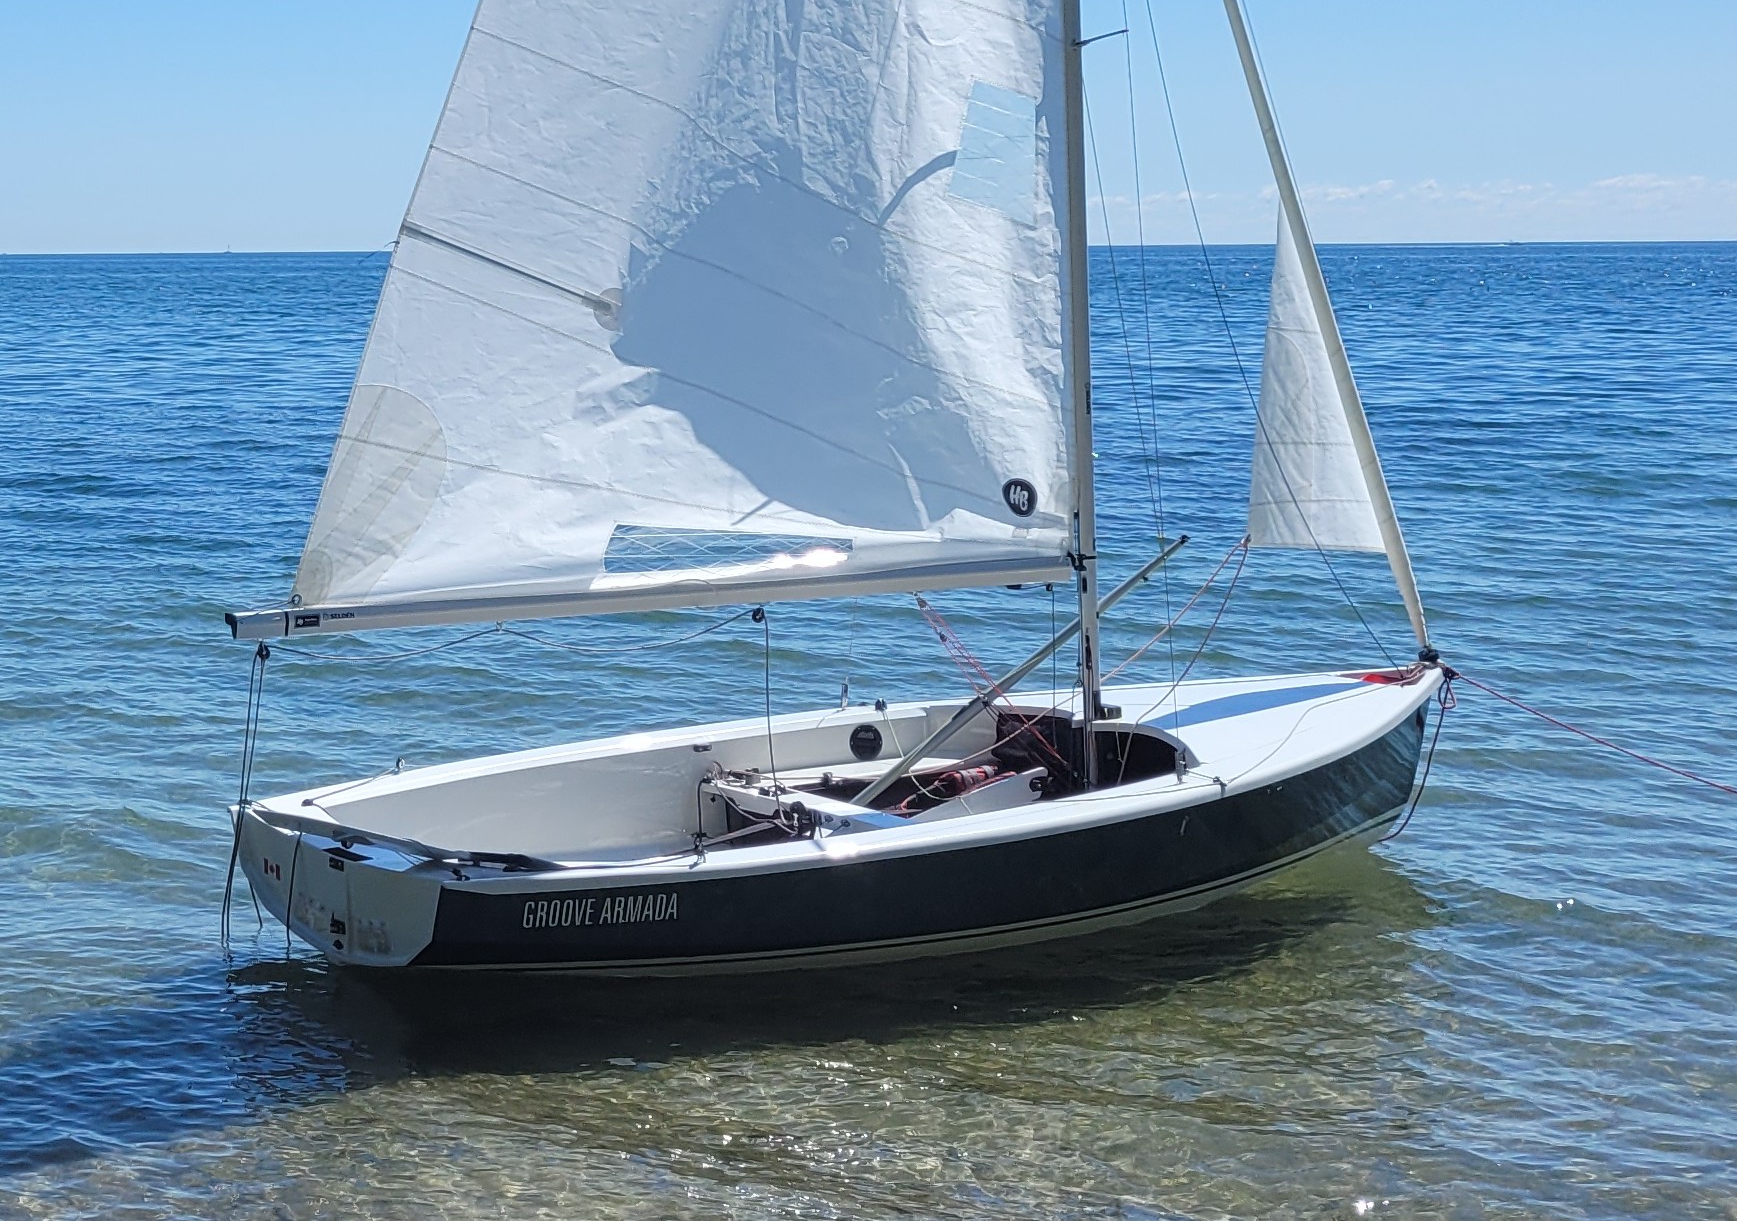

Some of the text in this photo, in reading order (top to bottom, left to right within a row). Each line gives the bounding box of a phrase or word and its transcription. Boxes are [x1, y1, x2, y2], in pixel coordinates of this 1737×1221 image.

[1009, 484, 1029, 512] HB
[522, 892, 678, 929] GROOVE ARMADA
